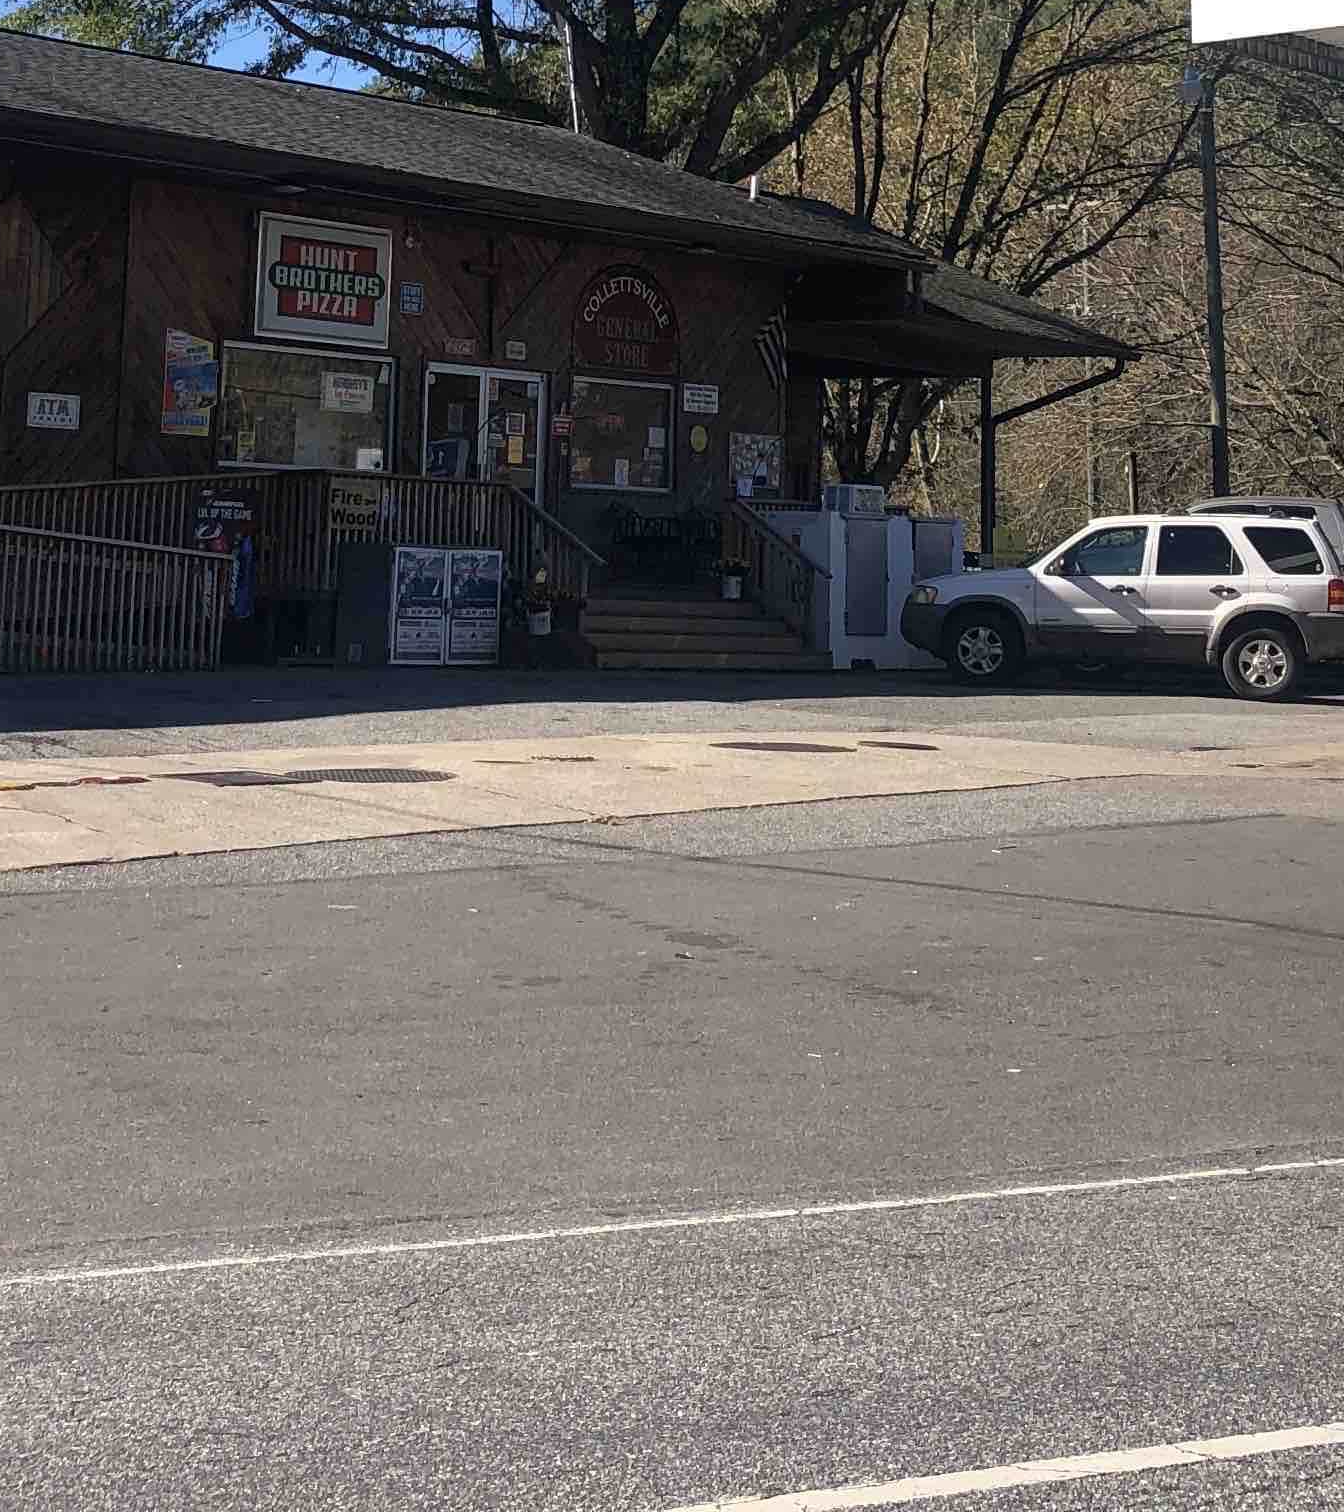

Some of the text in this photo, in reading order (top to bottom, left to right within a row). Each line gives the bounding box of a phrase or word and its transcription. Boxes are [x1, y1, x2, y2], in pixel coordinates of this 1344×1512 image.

[299, 245, 359, 273] HUNT
[274, 265, 381, 297] BROTHERS
[296, 290, 358, 317] PIZZA
[584, 276, 671, 328] COLLETTSVILLE
[597, 315, 656, 342] GENERAL
[606, 343, 649, 368] STORE
[38, 399, 70, 417] ATM
[331, 488, 362, 505] Fire
[331, 508, 377, 525] Wood
